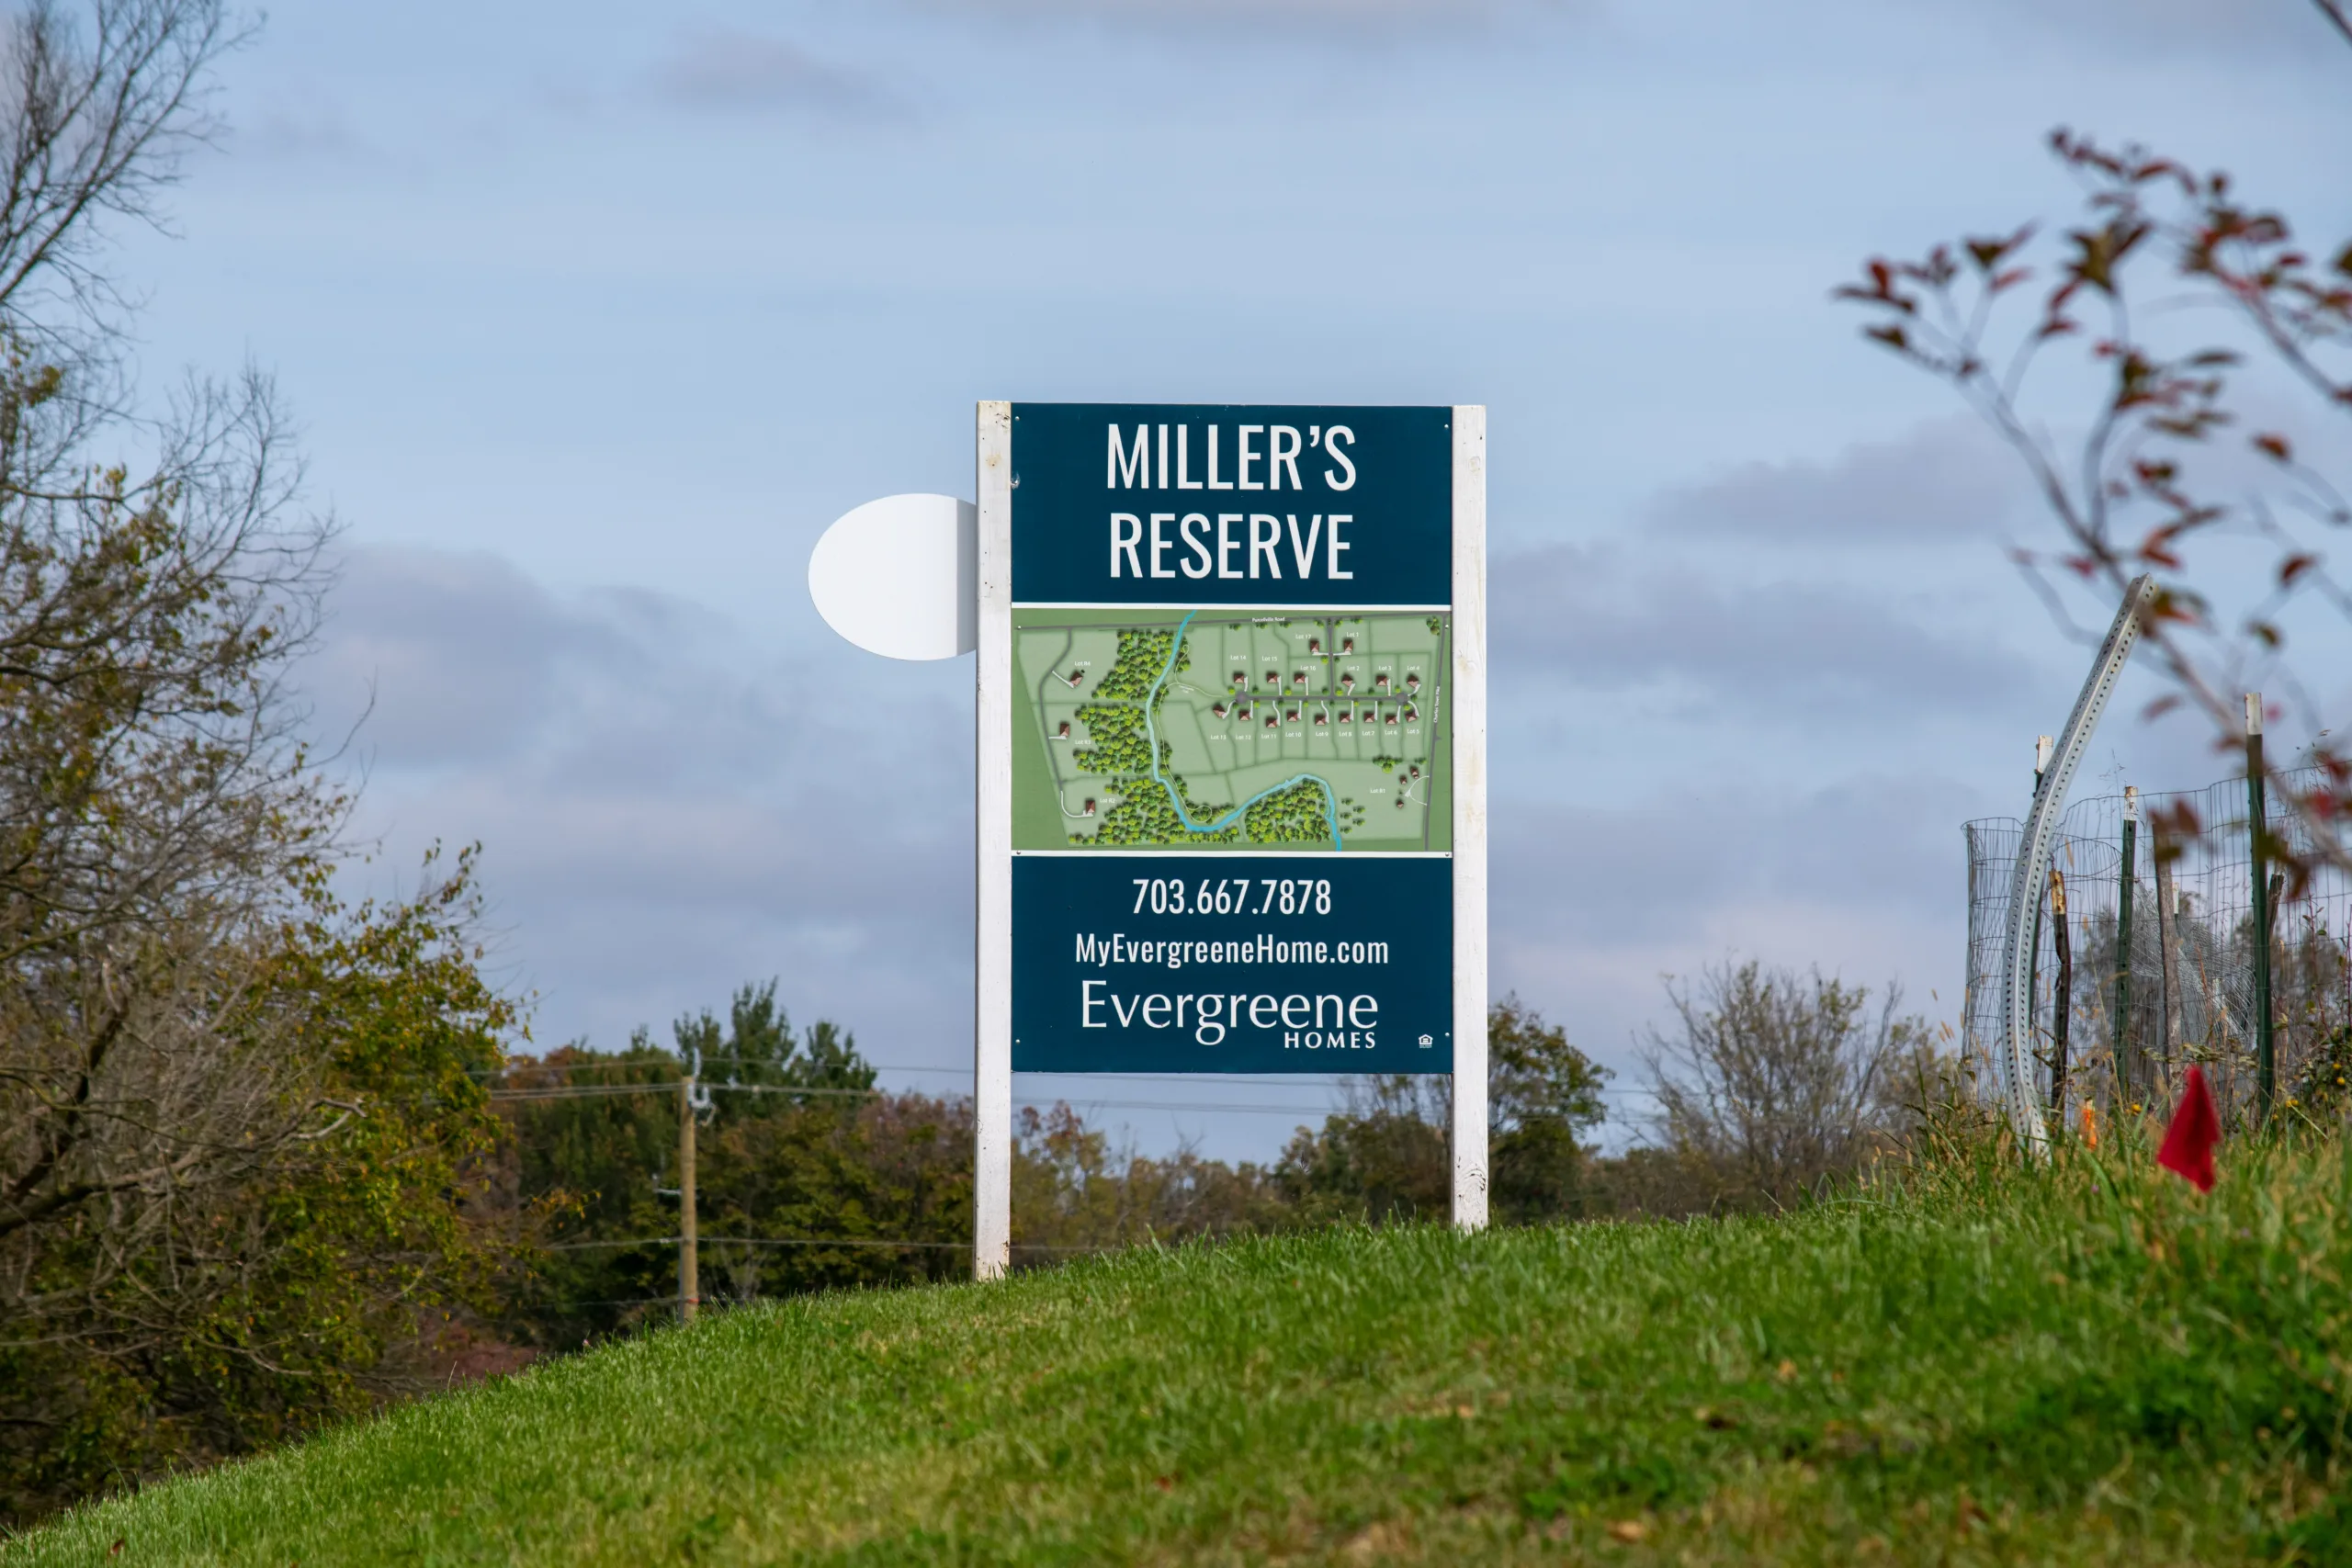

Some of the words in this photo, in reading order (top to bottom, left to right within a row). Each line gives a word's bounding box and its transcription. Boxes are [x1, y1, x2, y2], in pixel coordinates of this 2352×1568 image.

[1107, 423, 1357, 491] MILLER'S
[1110, 513, 1353, 580] RESERVE
[1133, 878, 1331, 915] 703.667.7878
[1076, 933, 1388, 969] MyEvergreeneHome.com
[1081, 980, 1378, 1046] Evergreene
[1284, 1032, 1376, 1049] HOMES
